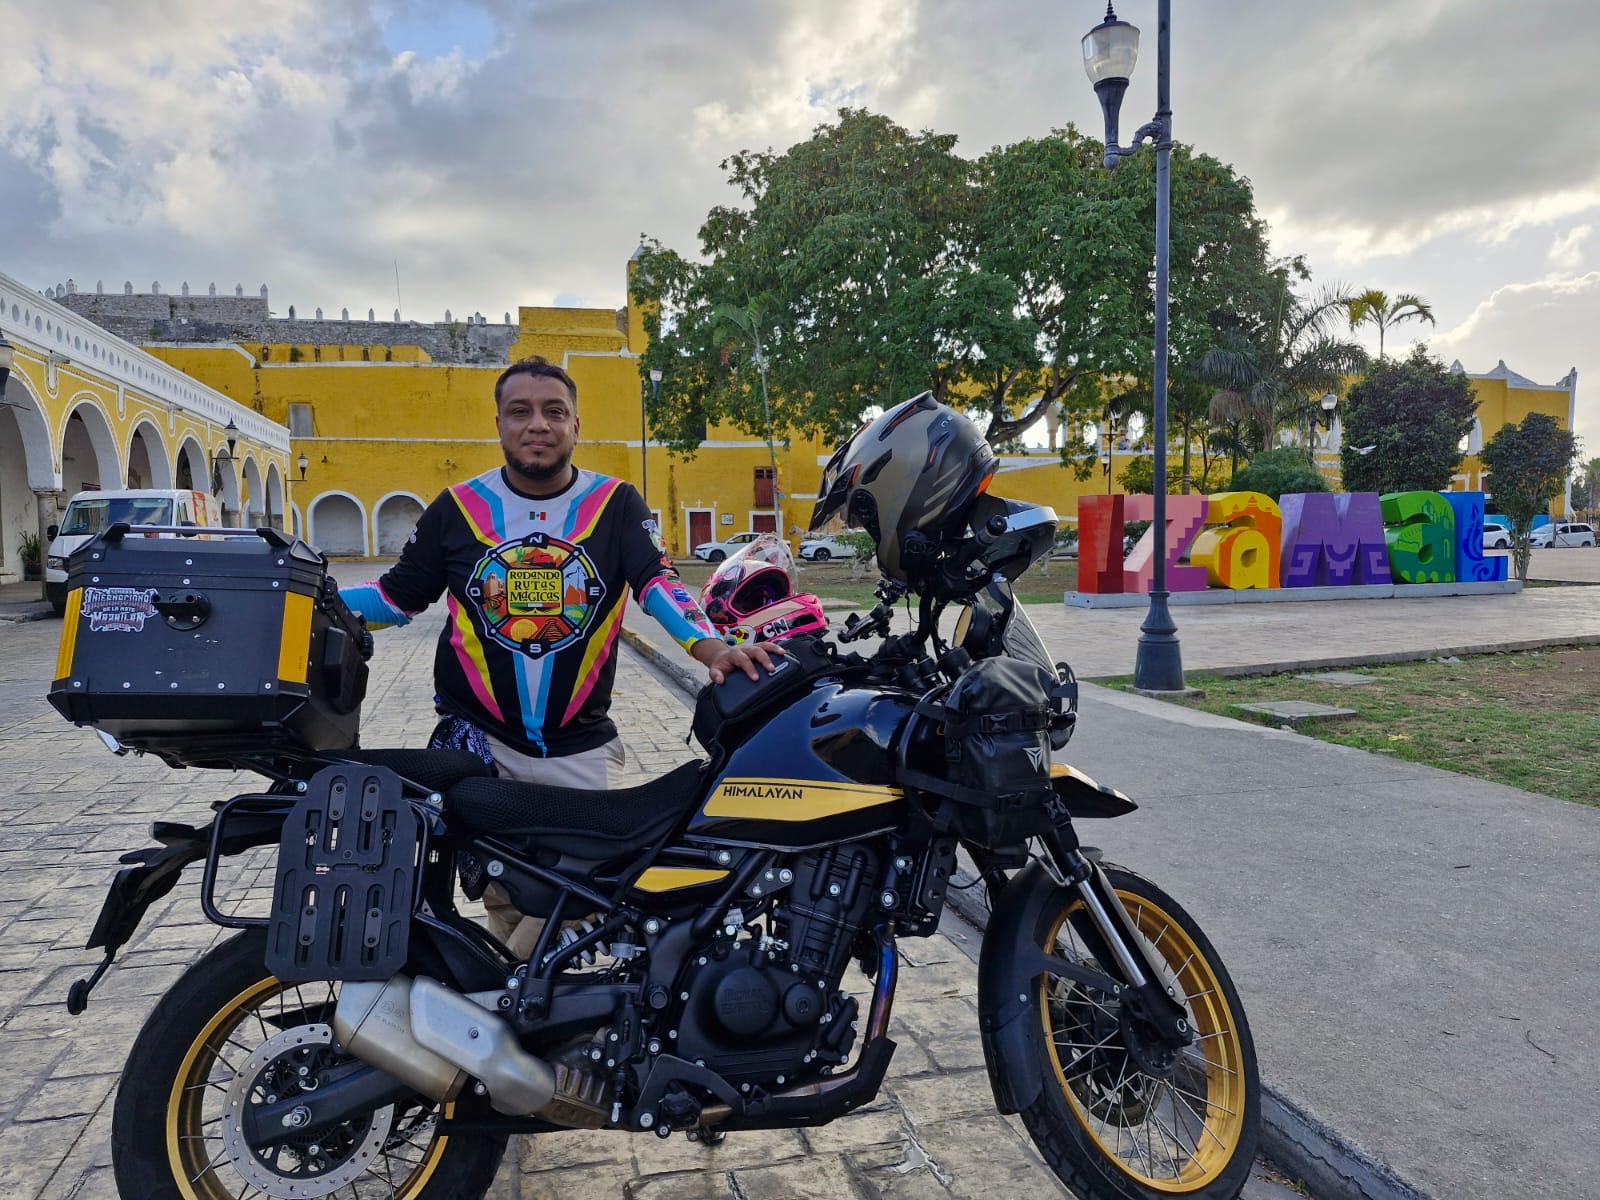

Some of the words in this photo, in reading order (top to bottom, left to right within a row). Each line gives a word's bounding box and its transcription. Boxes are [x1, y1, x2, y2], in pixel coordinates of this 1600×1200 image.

[529, 534, 542, 543] N
[589, 586, 600, 596] E
[762, 617, 789, 638] CN
[529, 643, 542, 653] S
[723, 785, 803, 800] HIMALAYAN
